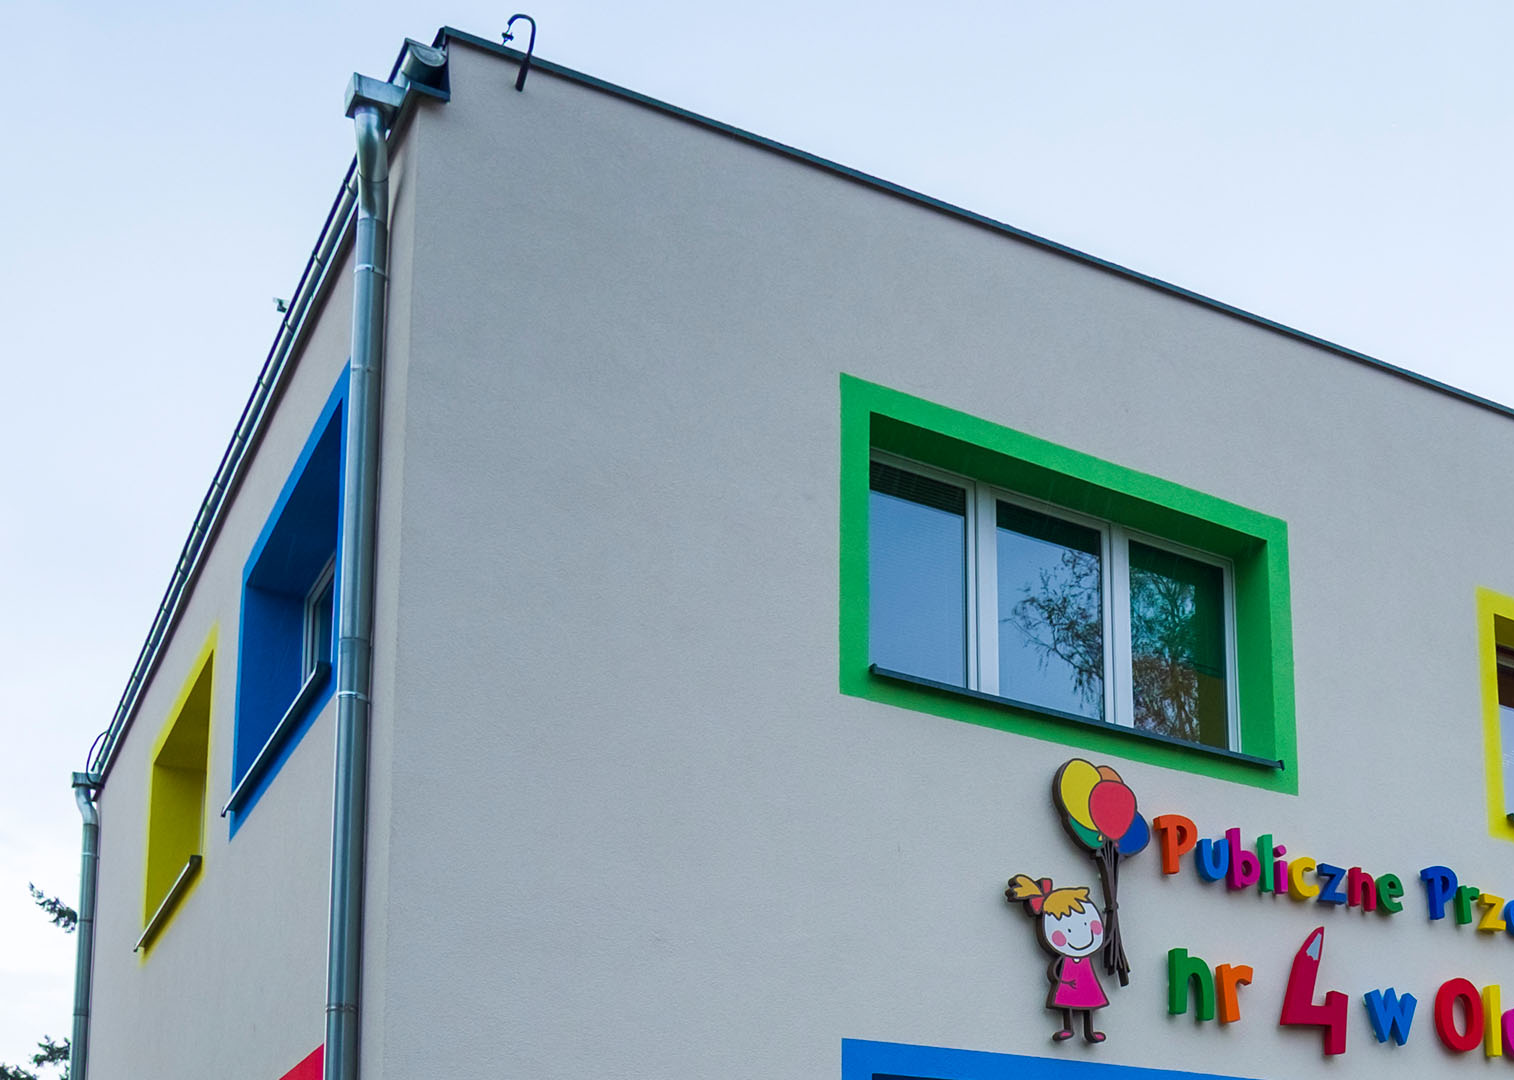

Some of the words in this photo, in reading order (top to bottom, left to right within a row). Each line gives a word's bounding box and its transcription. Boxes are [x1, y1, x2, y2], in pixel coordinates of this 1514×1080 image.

[1154, 814, 1403, 914] Publiczne
[1168, 948, 1253, 1023] nr
[1280, 927, 1349, 1055] 4
[1364, 987, 1418, 1046] w
